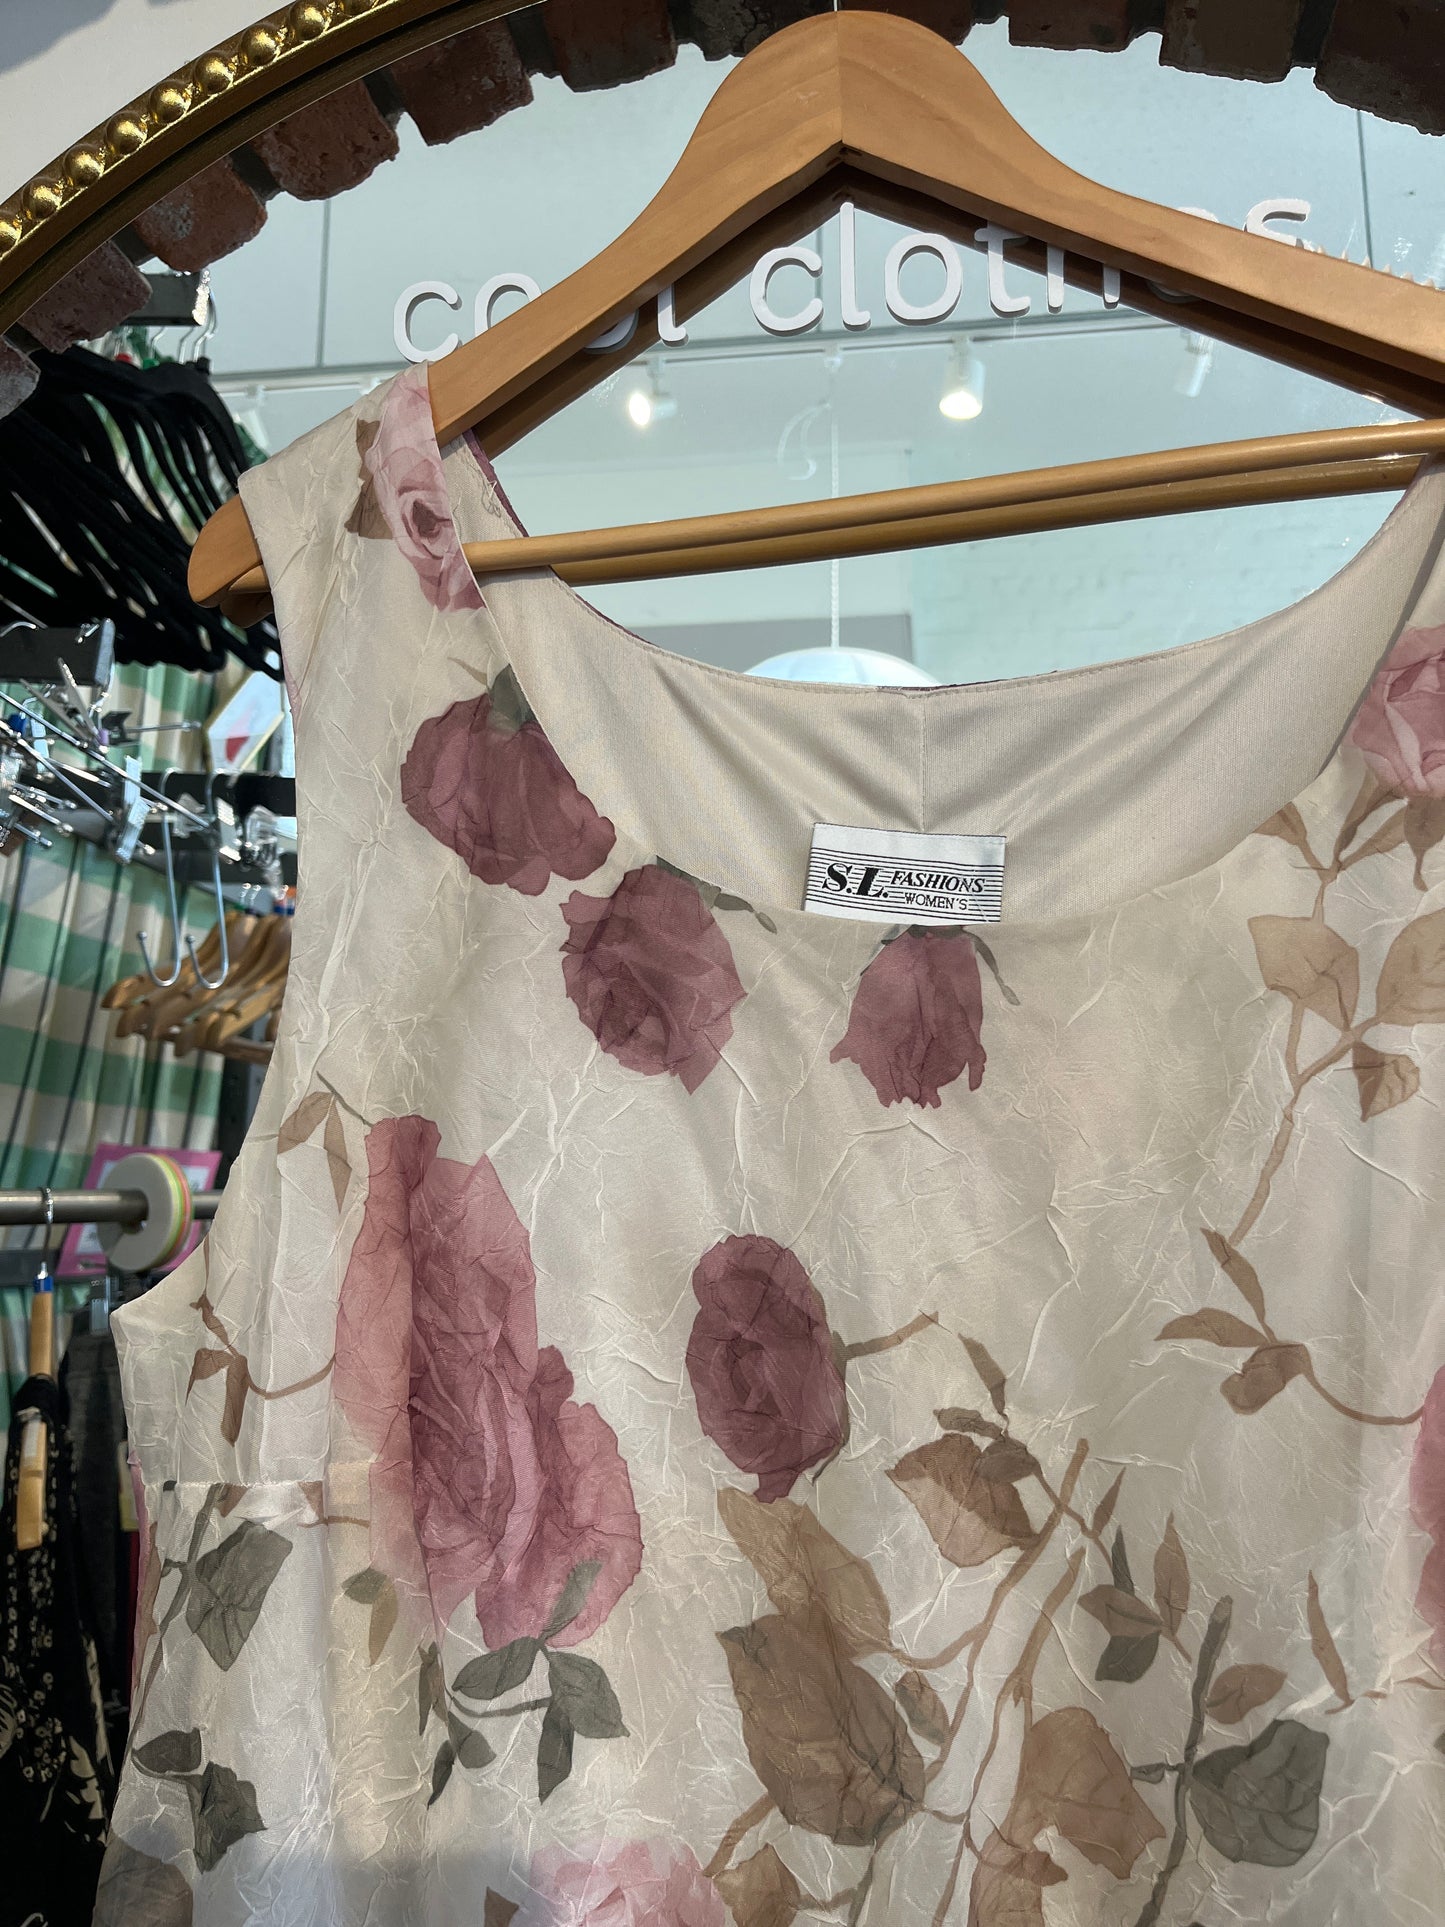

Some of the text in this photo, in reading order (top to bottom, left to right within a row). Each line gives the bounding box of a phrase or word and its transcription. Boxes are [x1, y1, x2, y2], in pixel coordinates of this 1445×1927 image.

[749, 197, 1311, 333] cloths
[822, 862, 986, 899] S.L. FASHIONS
[904, 891, 968, 911] WOMEN'S
